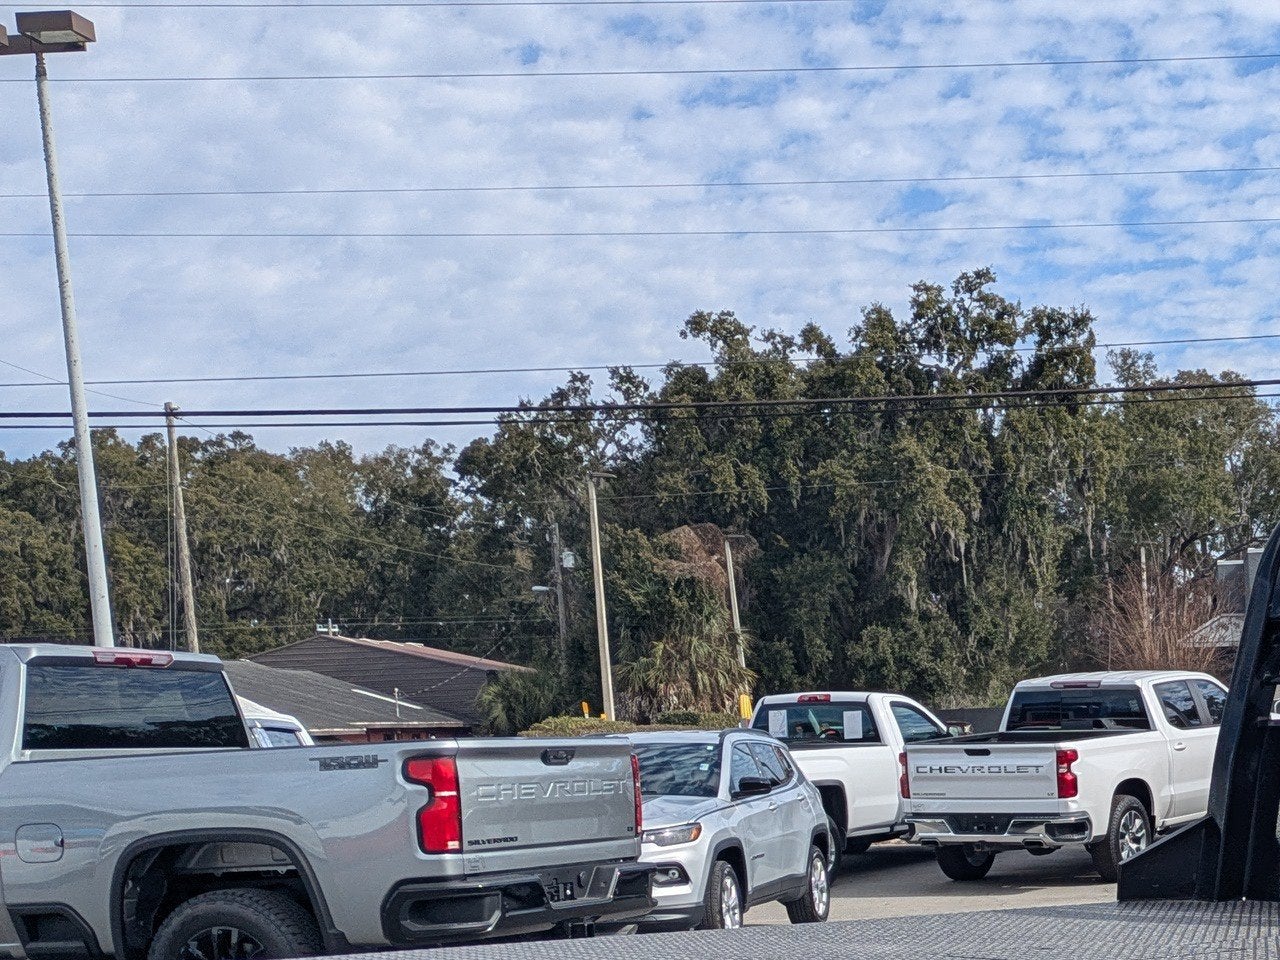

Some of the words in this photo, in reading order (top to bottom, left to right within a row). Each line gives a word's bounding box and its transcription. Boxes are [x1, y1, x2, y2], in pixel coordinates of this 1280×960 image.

[916, 765, 1044, 774] CHEVROLET
[476, 780, 627, 801] CHEVROLET
[467, 836, 518, 846] SILVERADO
